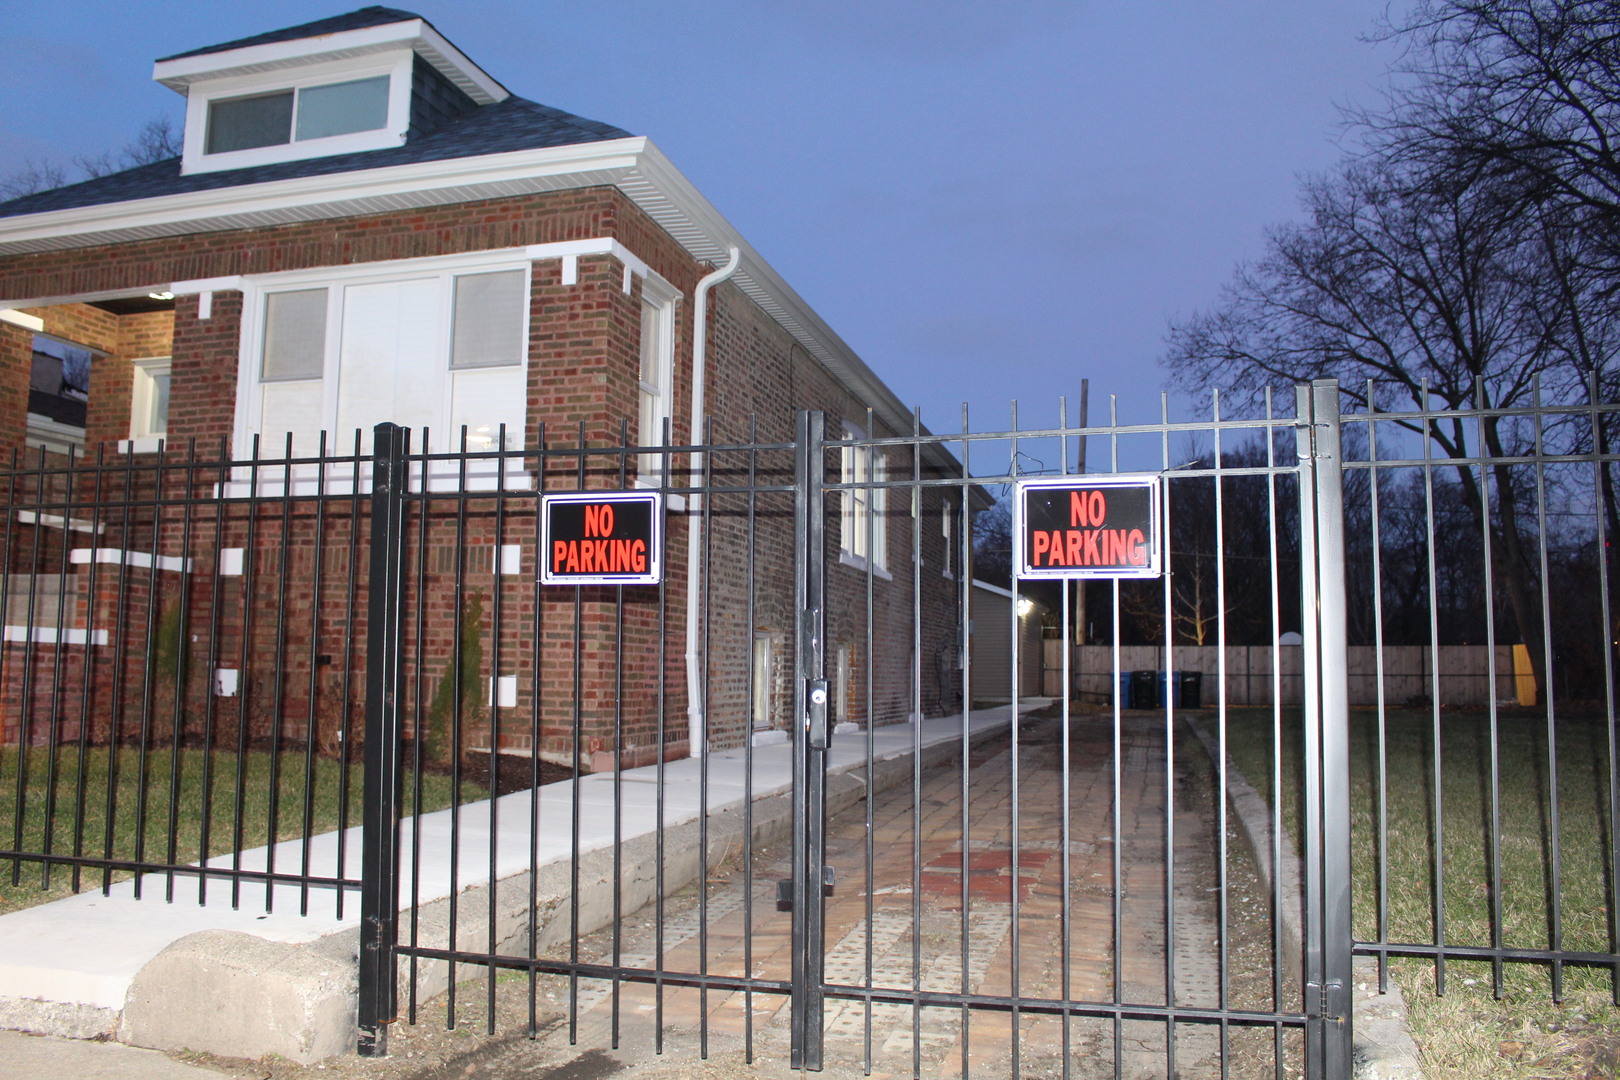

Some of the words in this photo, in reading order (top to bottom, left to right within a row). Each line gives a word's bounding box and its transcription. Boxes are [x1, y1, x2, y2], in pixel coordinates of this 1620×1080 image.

[584, 504, 615, 538] NO
[1070, 490, 1107, 527] NO
[553, 538, 647, 573] PARKING
[1033, 528, 1147, 567] PARKING
